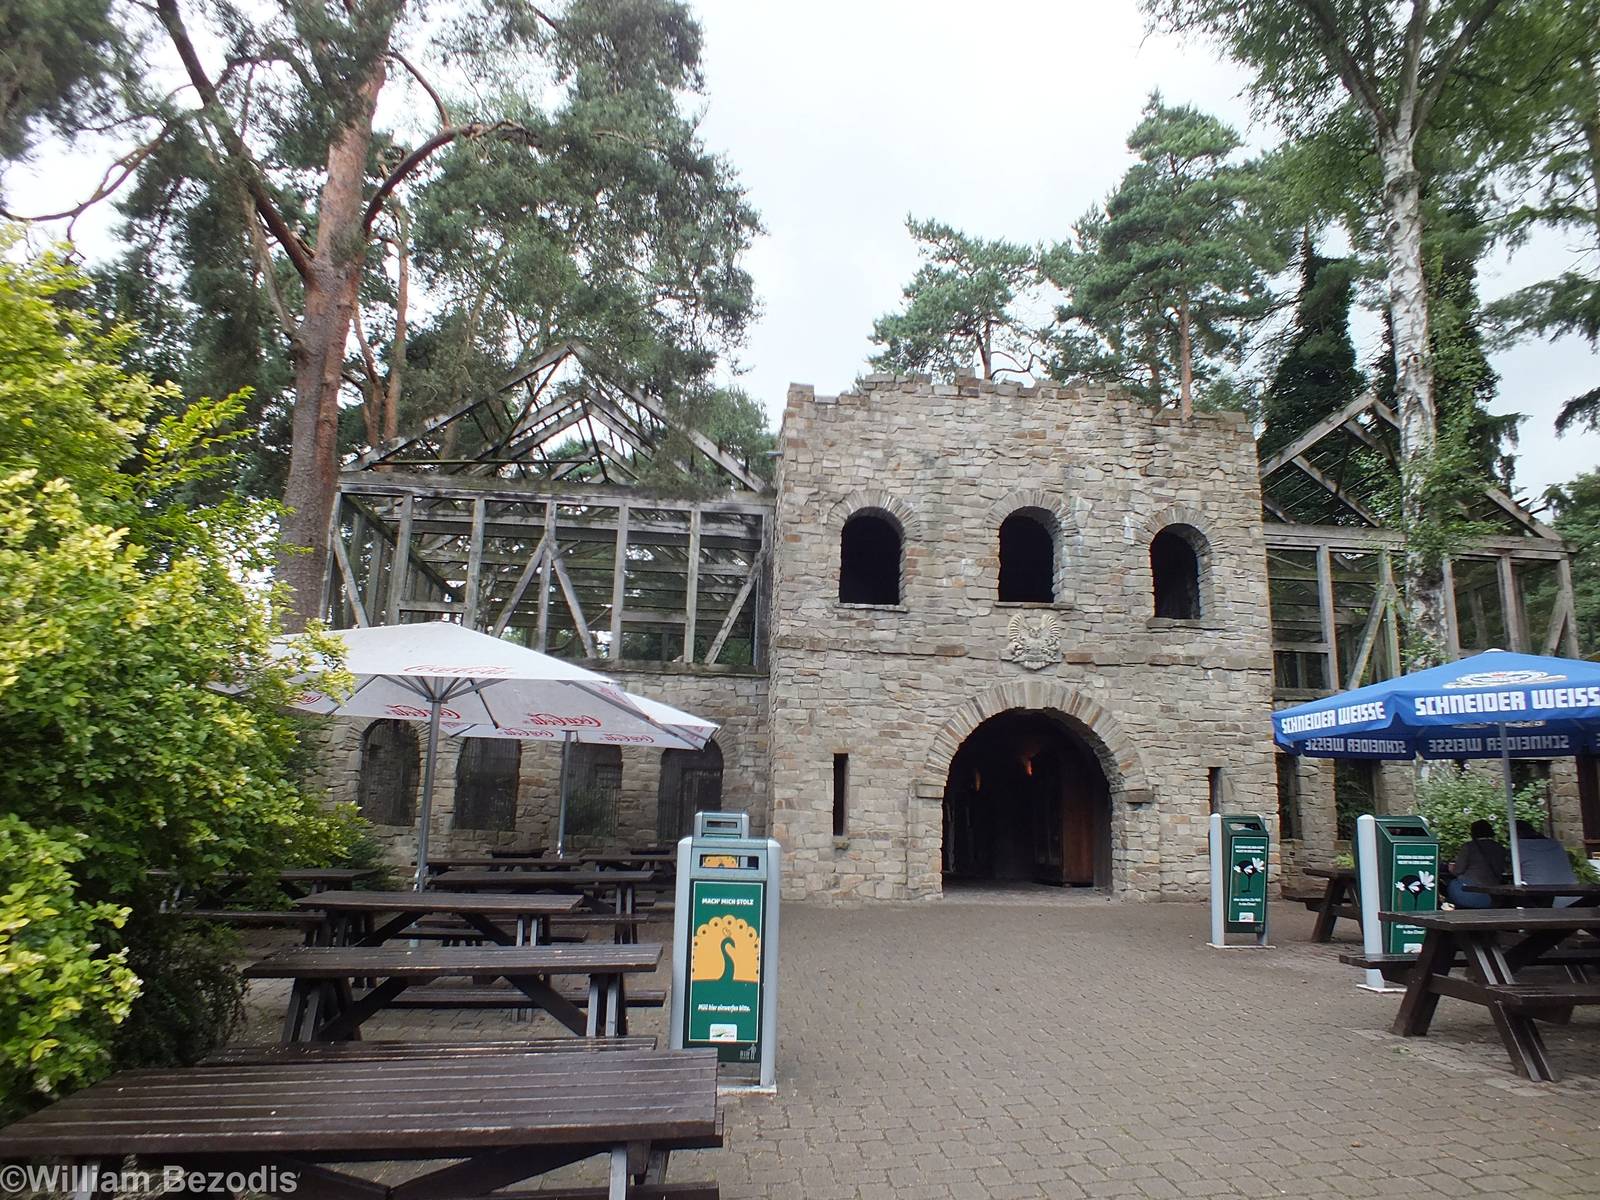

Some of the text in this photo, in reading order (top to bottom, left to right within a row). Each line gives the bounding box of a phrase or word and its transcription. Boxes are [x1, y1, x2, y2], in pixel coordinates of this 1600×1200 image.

[1415, 687, 1600, 716] SCHNEIDER WEISS
[1281, 701, 1386, 734] SCHNEIDER WEISSE
